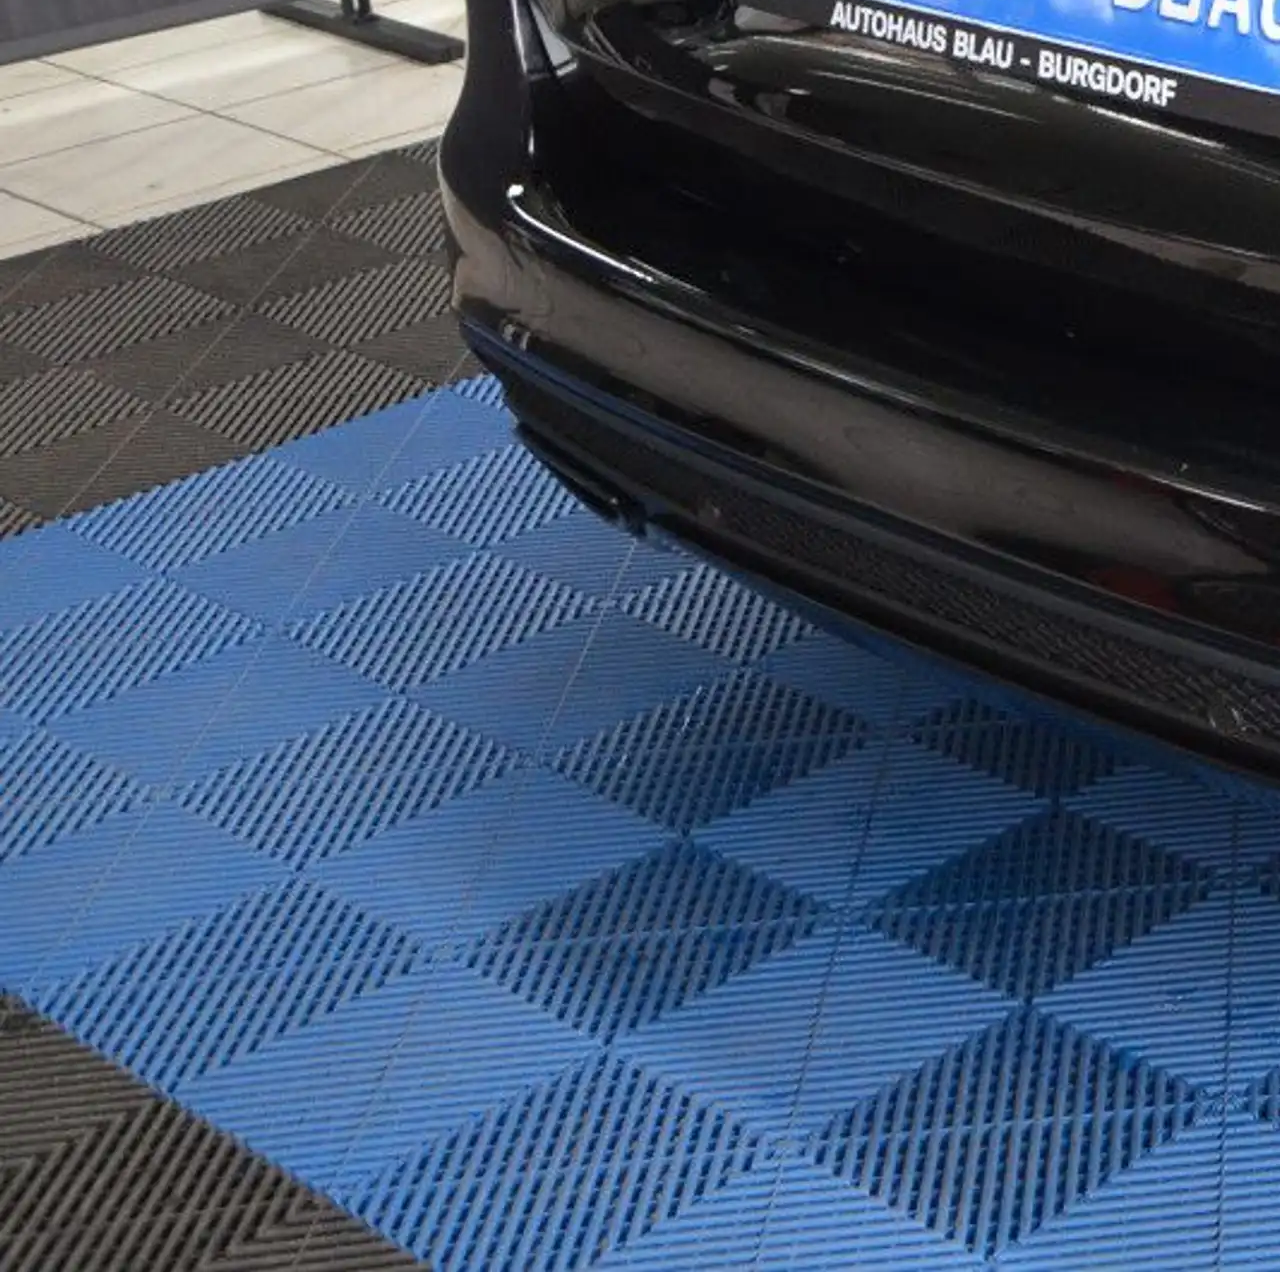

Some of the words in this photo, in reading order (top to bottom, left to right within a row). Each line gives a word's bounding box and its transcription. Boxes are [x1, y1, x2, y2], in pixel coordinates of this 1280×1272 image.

[831, 1, 947, 52] AUTOHAUS
[953, 29, 1013, 68] BLAU
[1038, 50, 1177, 107] BURGDORF
